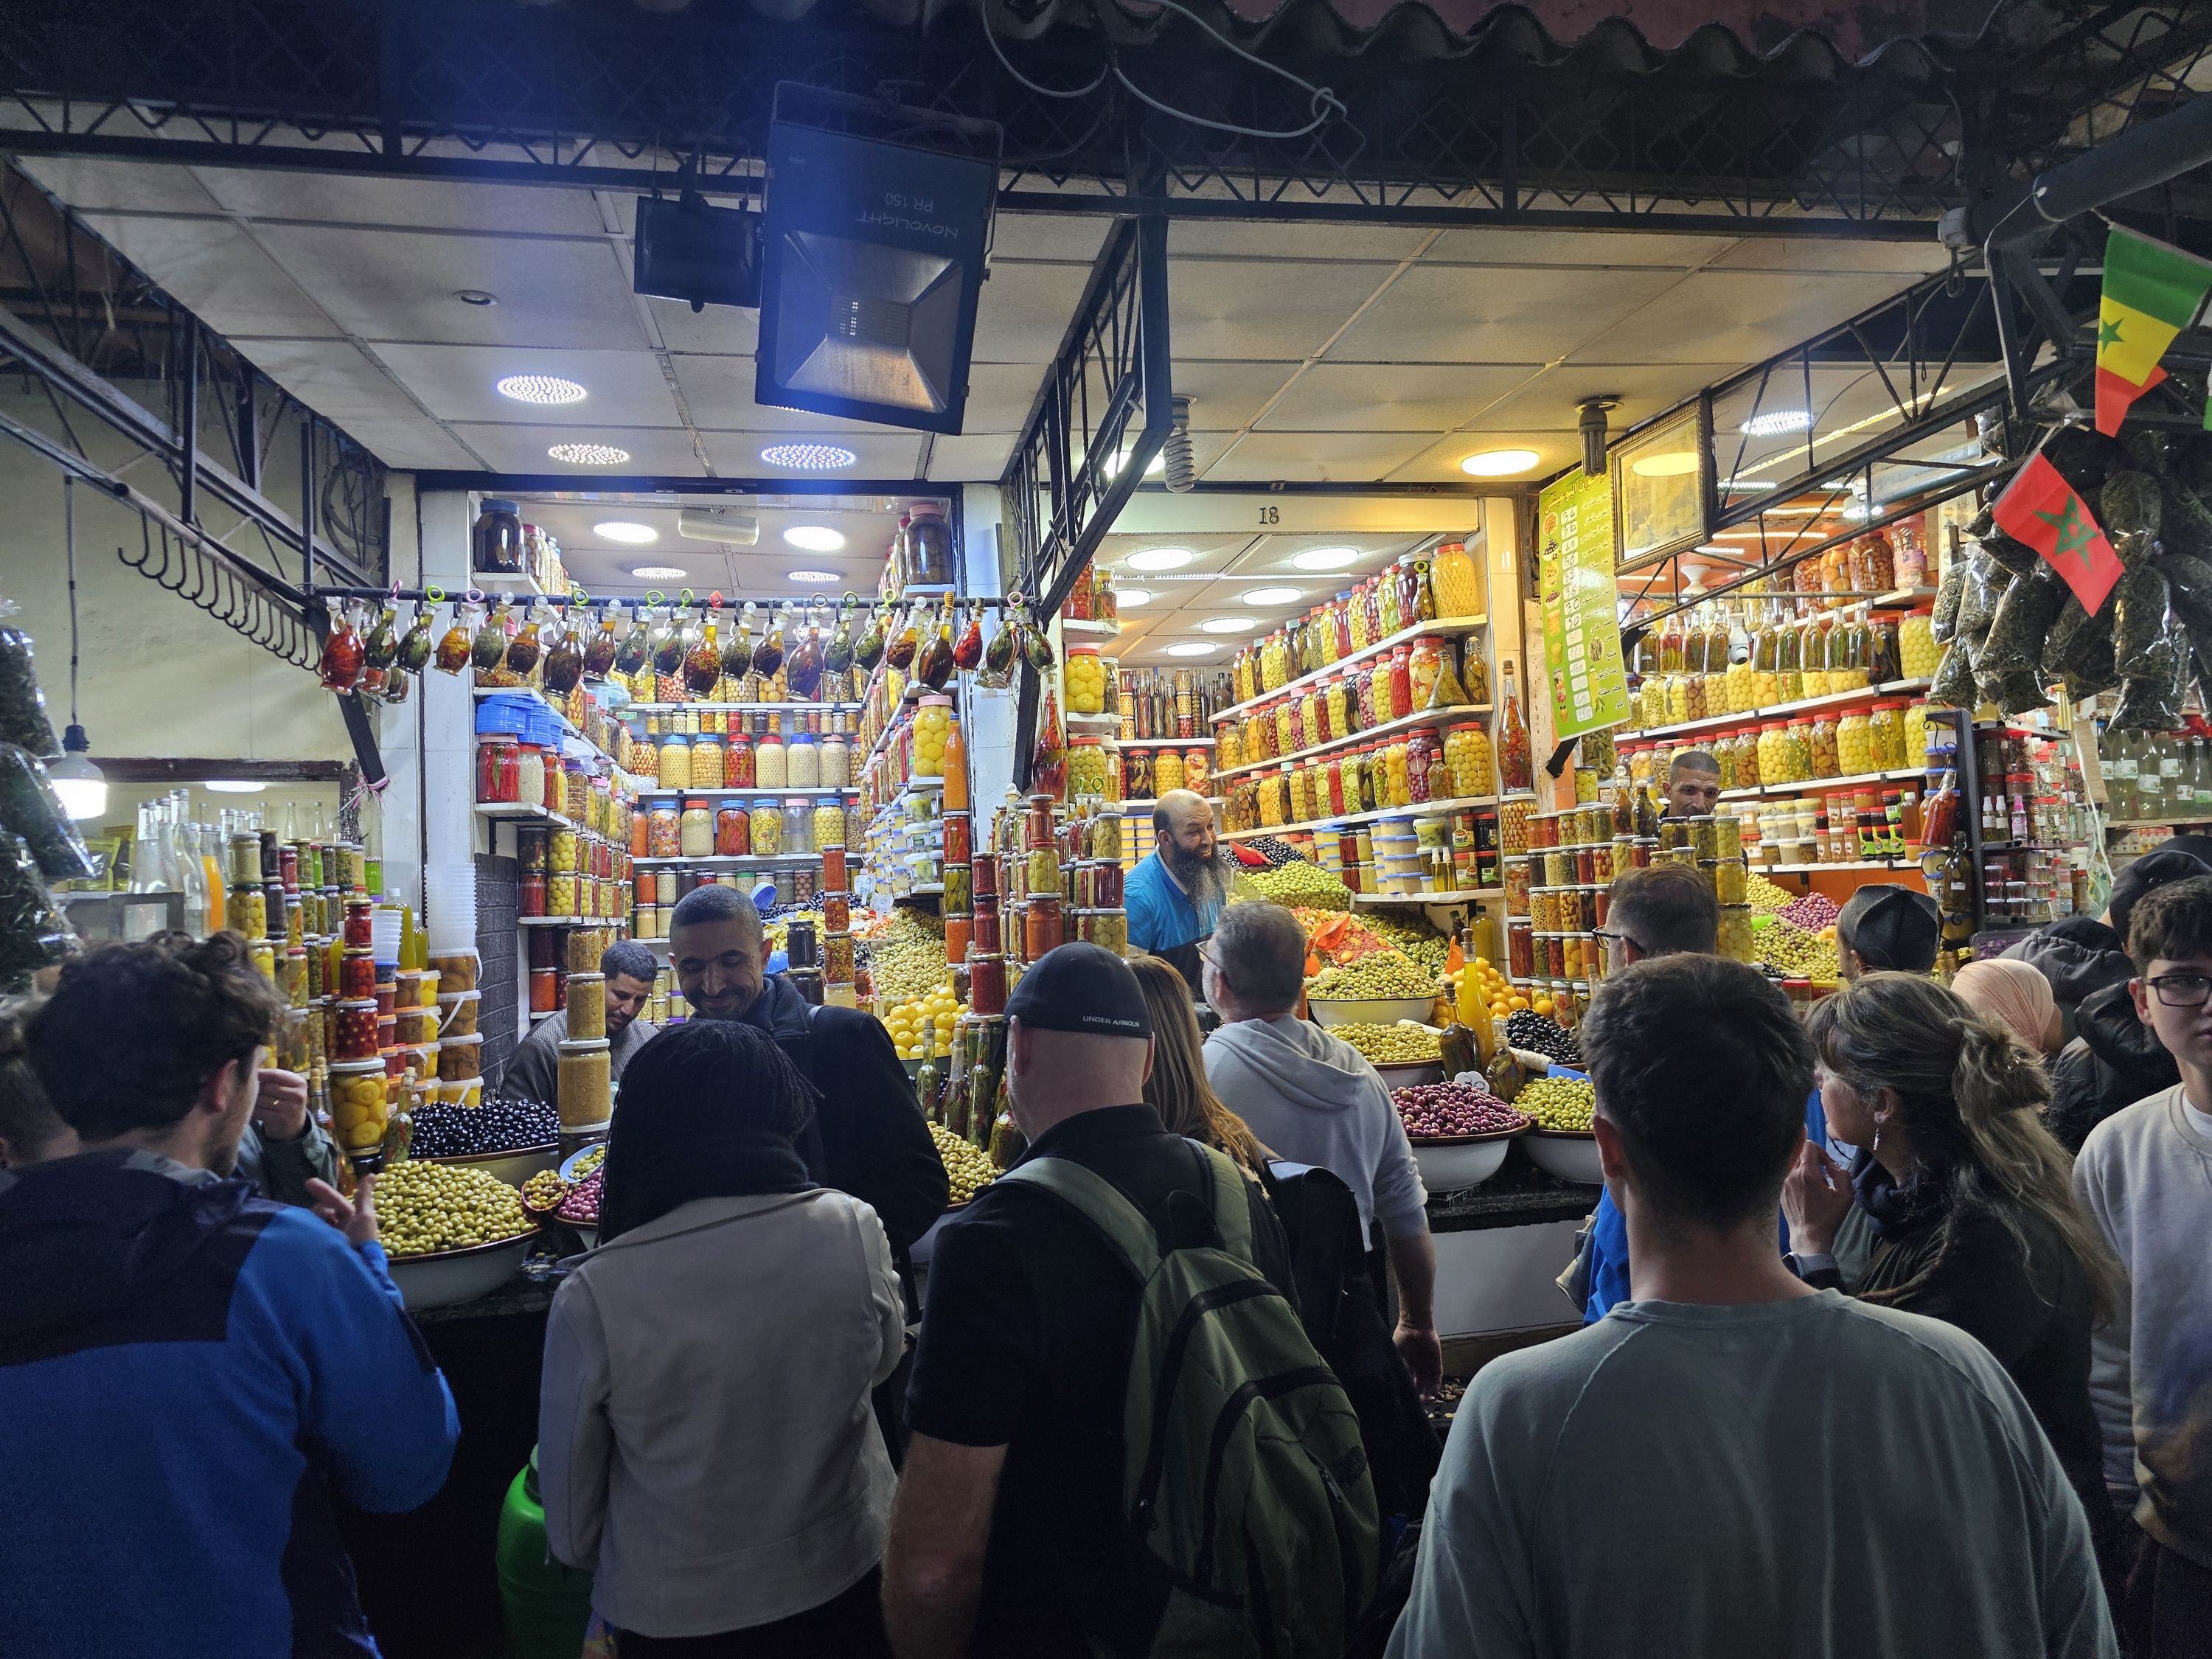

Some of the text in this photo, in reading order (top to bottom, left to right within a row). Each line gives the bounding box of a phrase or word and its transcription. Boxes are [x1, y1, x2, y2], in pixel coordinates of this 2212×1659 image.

[885, 192, 933, 212] PR 150
[855, 212, 959, 239] NOVOLIGHT
[1259, 506, 1280, 524] 18
[1565, 582, 1576, 597] 36
[1565, 598, 1579, 613] 30
[1568, 614, 1579, 629] 50
[1083, 1016, 1140, 1028] UNDER ARMOUR
